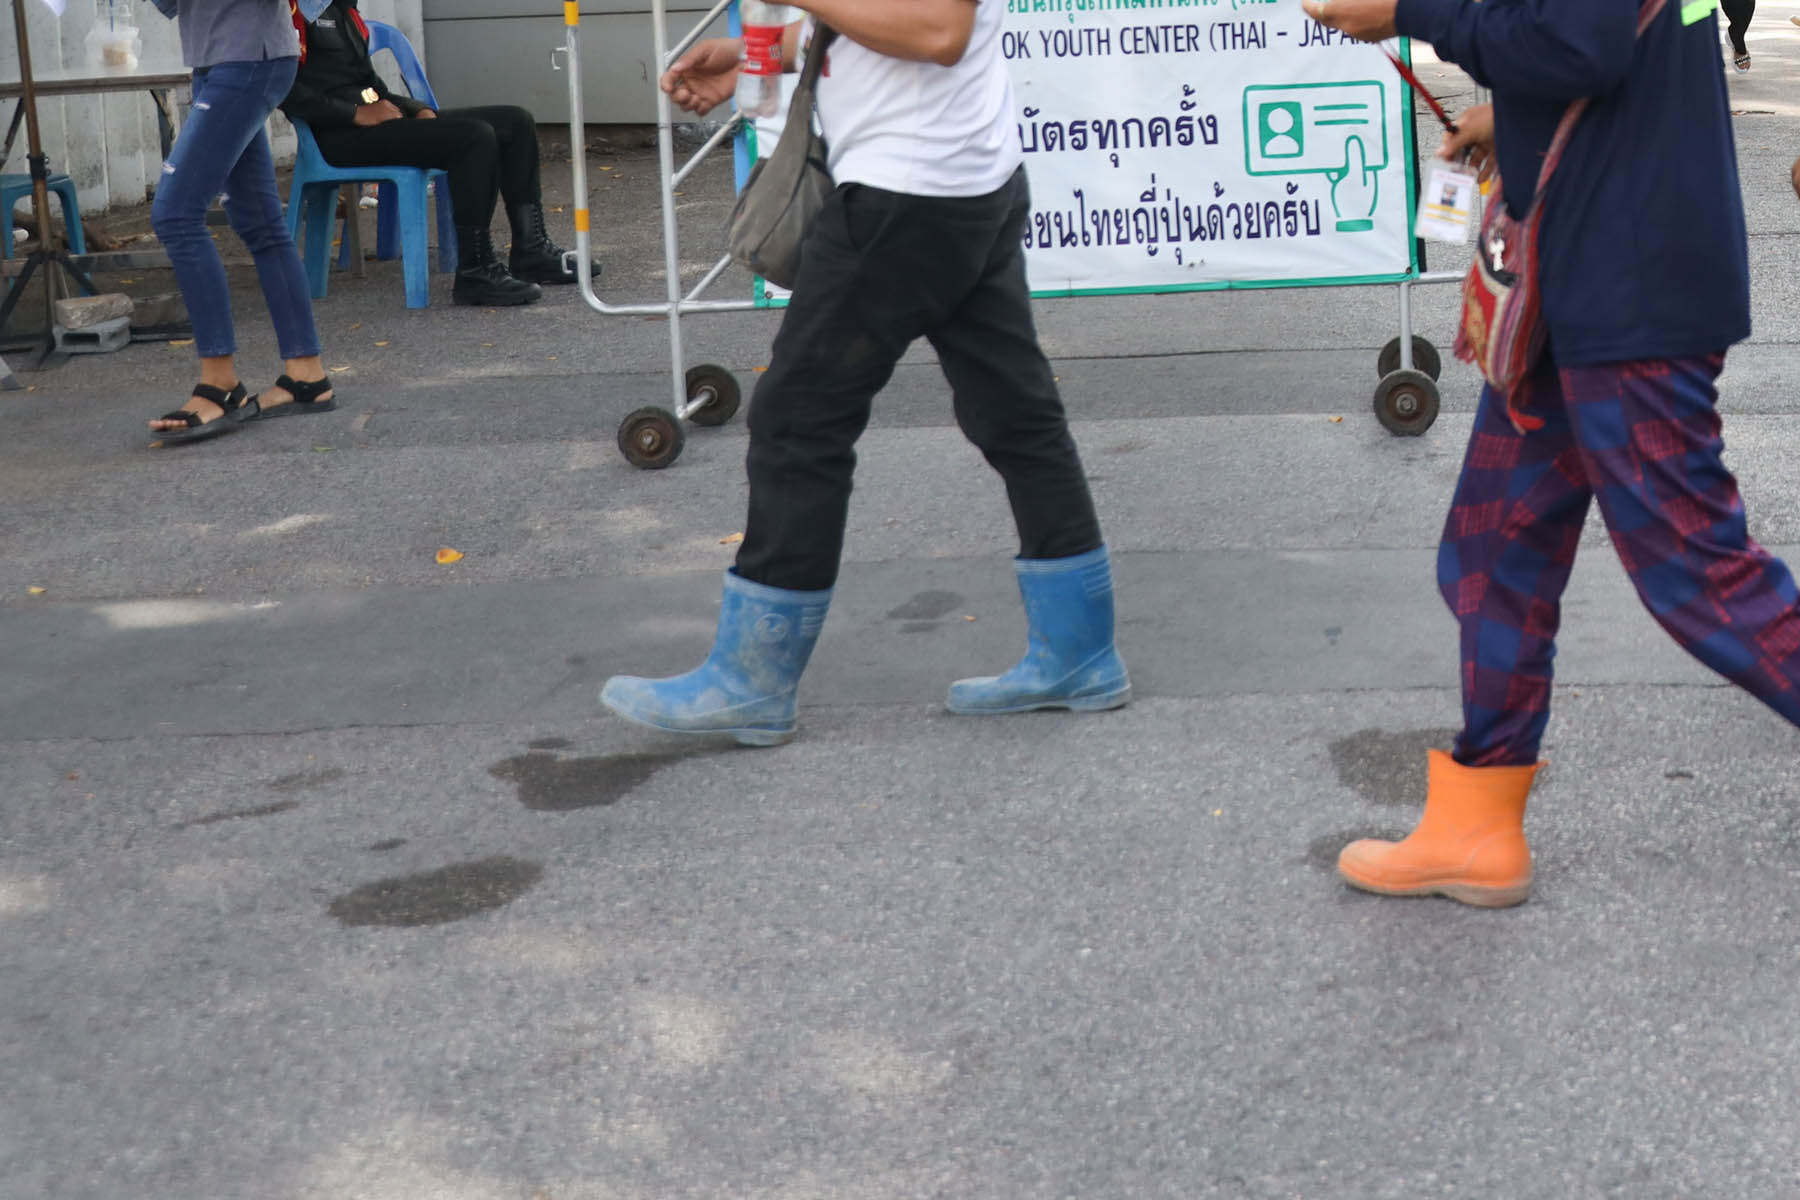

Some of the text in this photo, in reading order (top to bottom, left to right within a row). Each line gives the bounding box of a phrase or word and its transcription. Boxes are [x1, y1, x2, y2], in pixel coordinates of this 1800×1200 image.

[1039, 27, 1111, 58] YOUTH
[1120, 24, 1200, 55] CENTER
[1209, 20, 1267, 52] (THAI
[1018, 84, 1219, 168] บัตรทุกครั้ง
